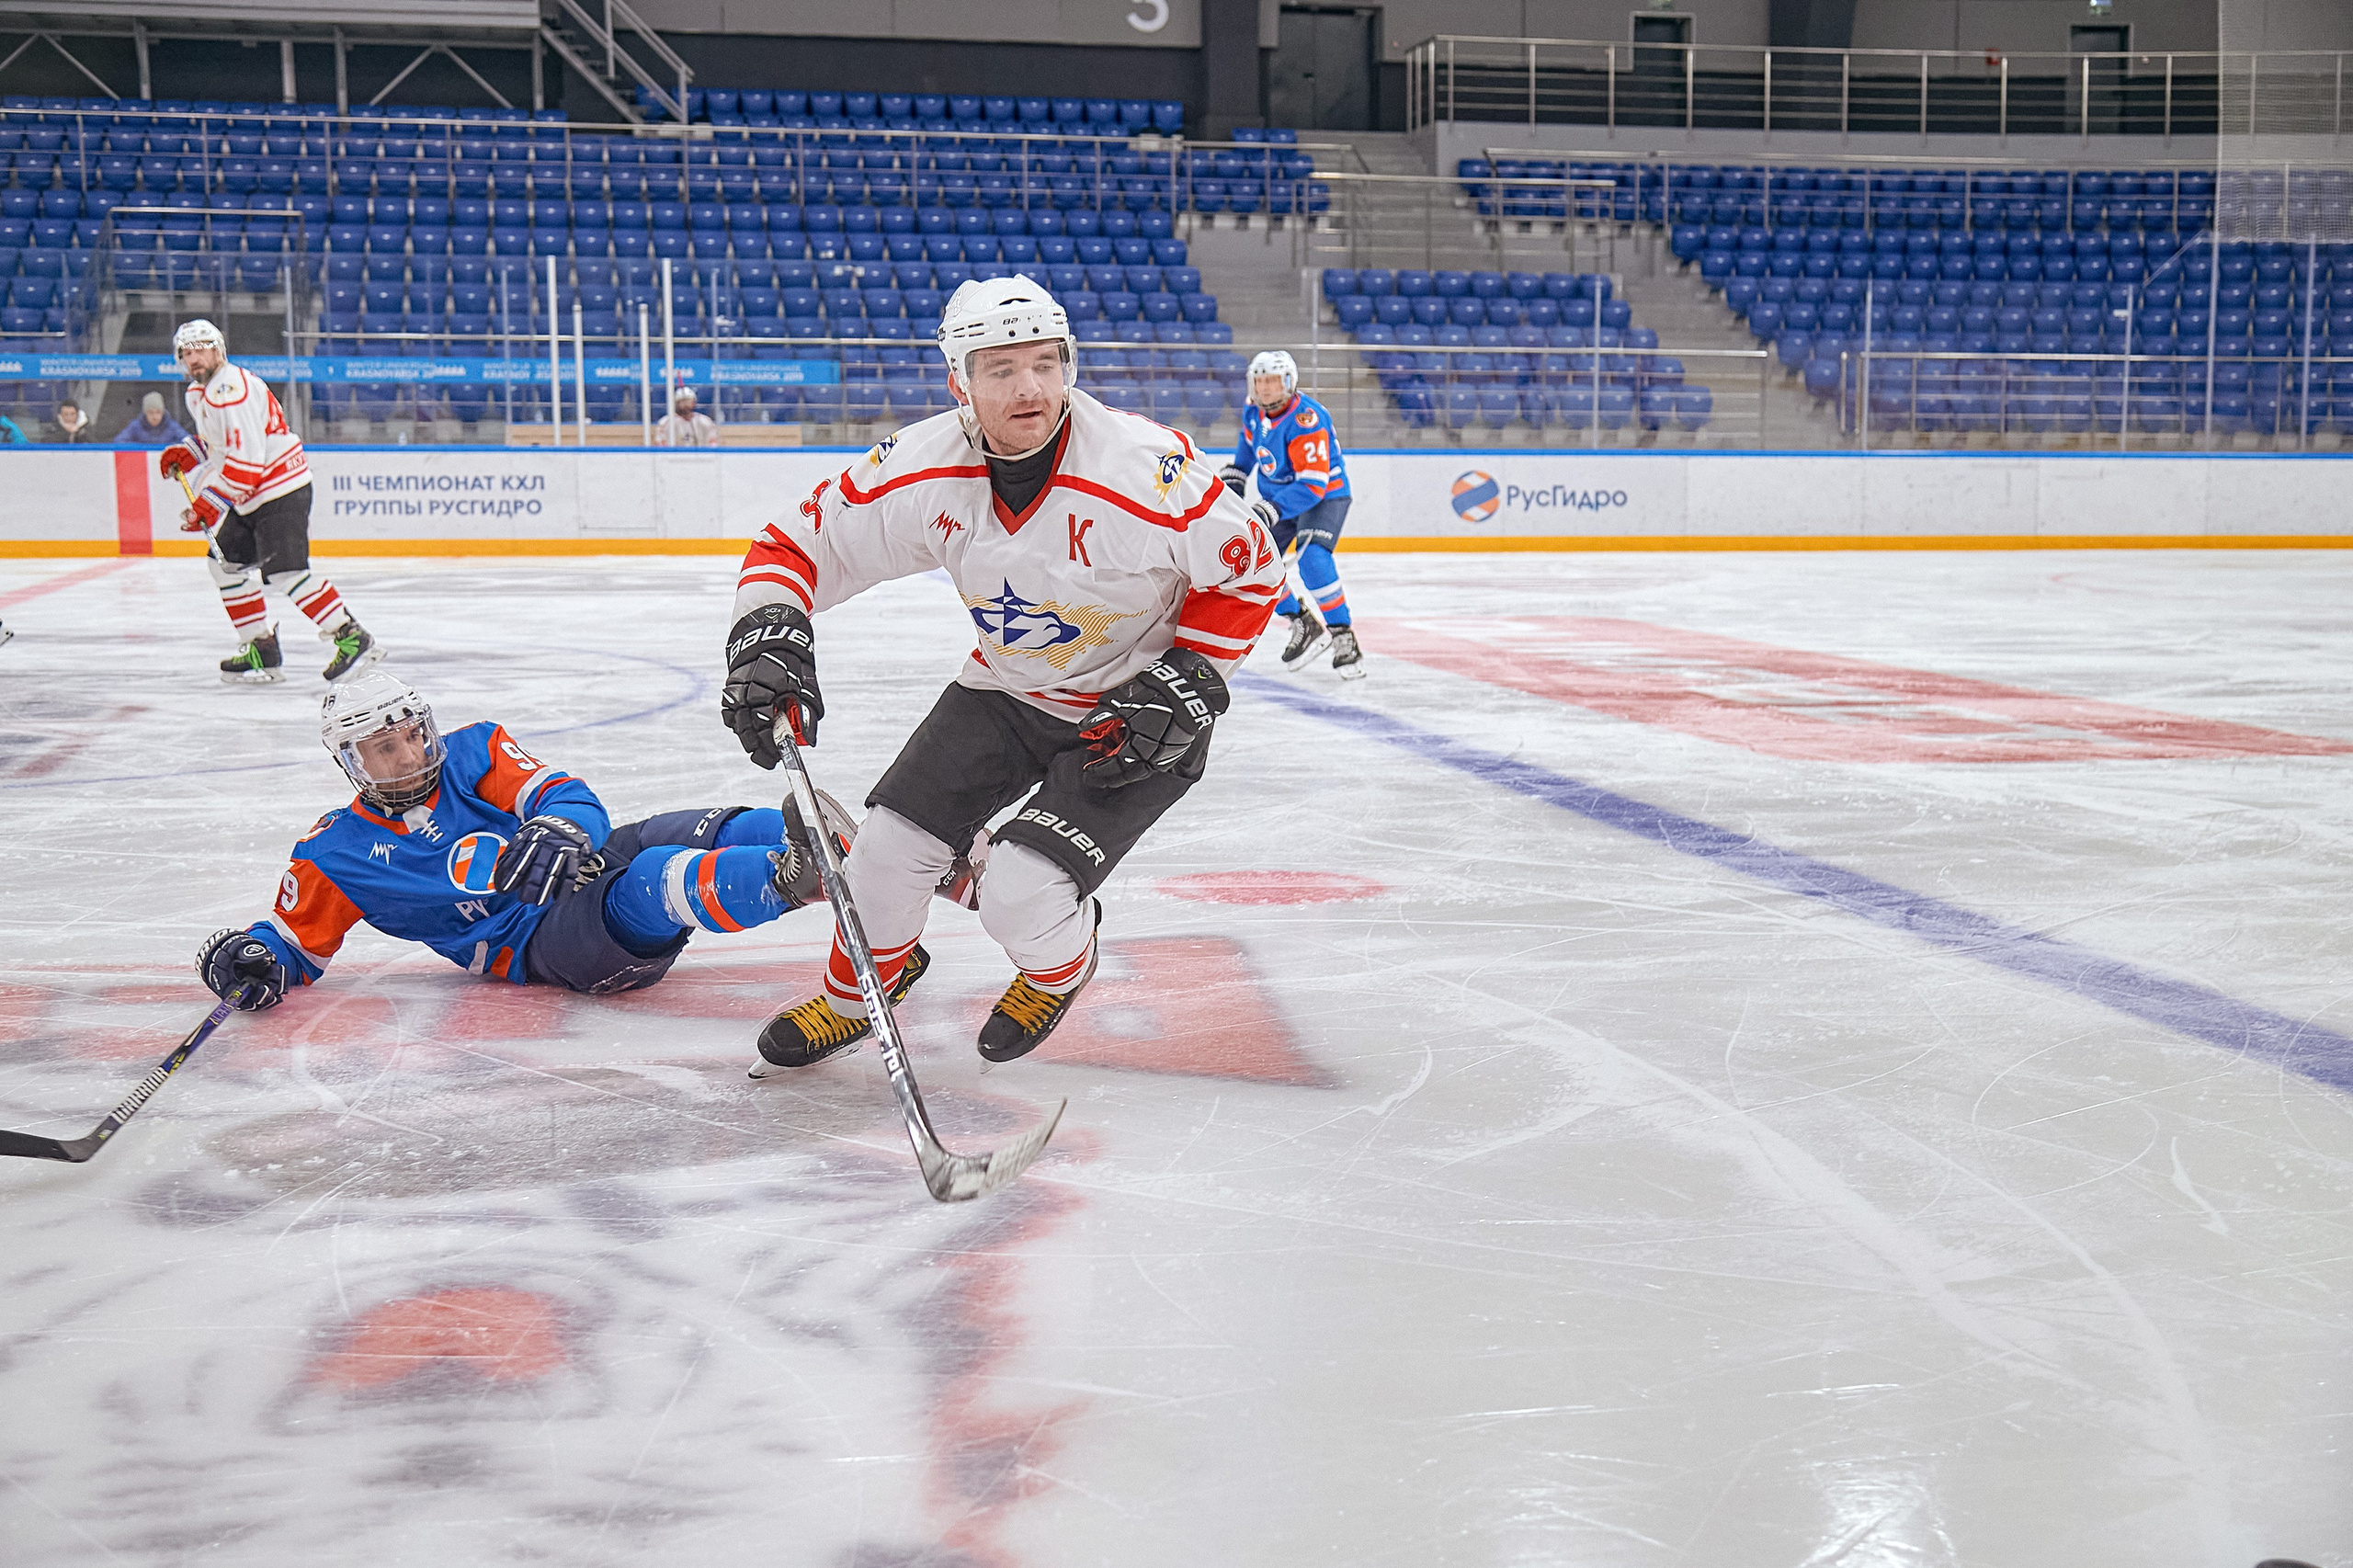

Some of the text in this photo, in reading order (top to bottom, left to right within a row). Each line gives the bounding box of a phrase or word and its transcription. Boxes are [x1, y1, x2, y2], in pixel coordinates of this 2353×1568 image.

[1303, 439, 1328, 463] 24
[333, 475, 545, 491] III ЧЕМПИОНАТ КХЛ
[335, 499, 542, 517] ГРУППЫ РУСГИДРО
[1506, 484, 1628, 512] РусГидро
[1219, 517, 1274, 577] 82
[693, 808, 722, 837] CC
[1017, 808, 1106, 868] BAUER
[942, 869, 957, 886] CCM
[109, 1065, 170, 1124] WARRIOR
